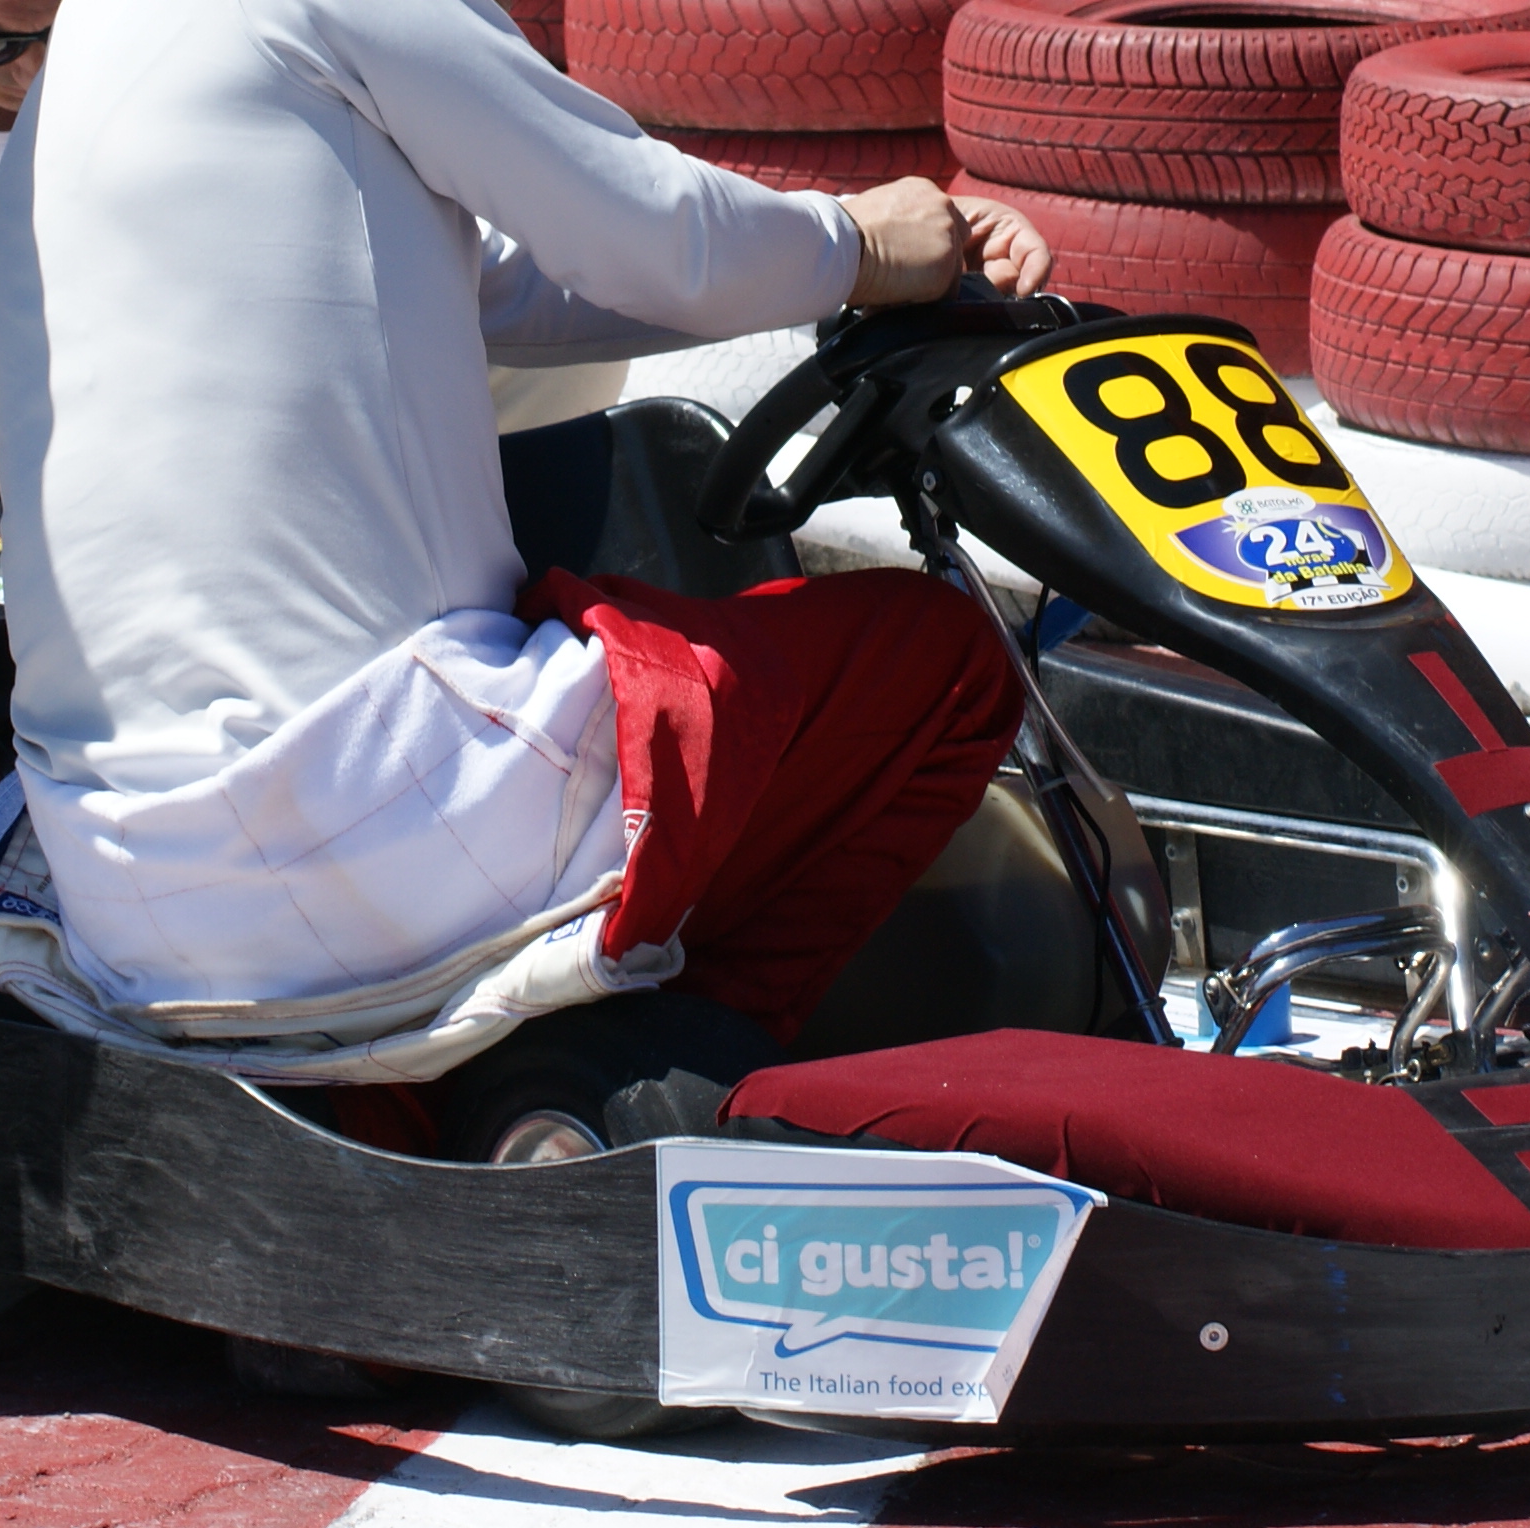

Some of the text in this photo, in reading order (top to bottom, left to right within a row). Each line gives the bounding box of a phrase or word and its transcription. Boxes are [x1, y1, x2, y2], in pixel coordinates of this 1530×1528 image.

[1063, 342, 1351, 509] 88
[1249, 520, 1335, 567] 24
[1272, 561, 1367, 585] da Batalha
[1327, 588, 1380, 606] EDIÇÃO
[724, 1224, 780, 1285] ci
[760, 1371, 801, 1394] The
[809, 1372, 881, 1396] Italian
[888, 1373, 943, 1397] food
